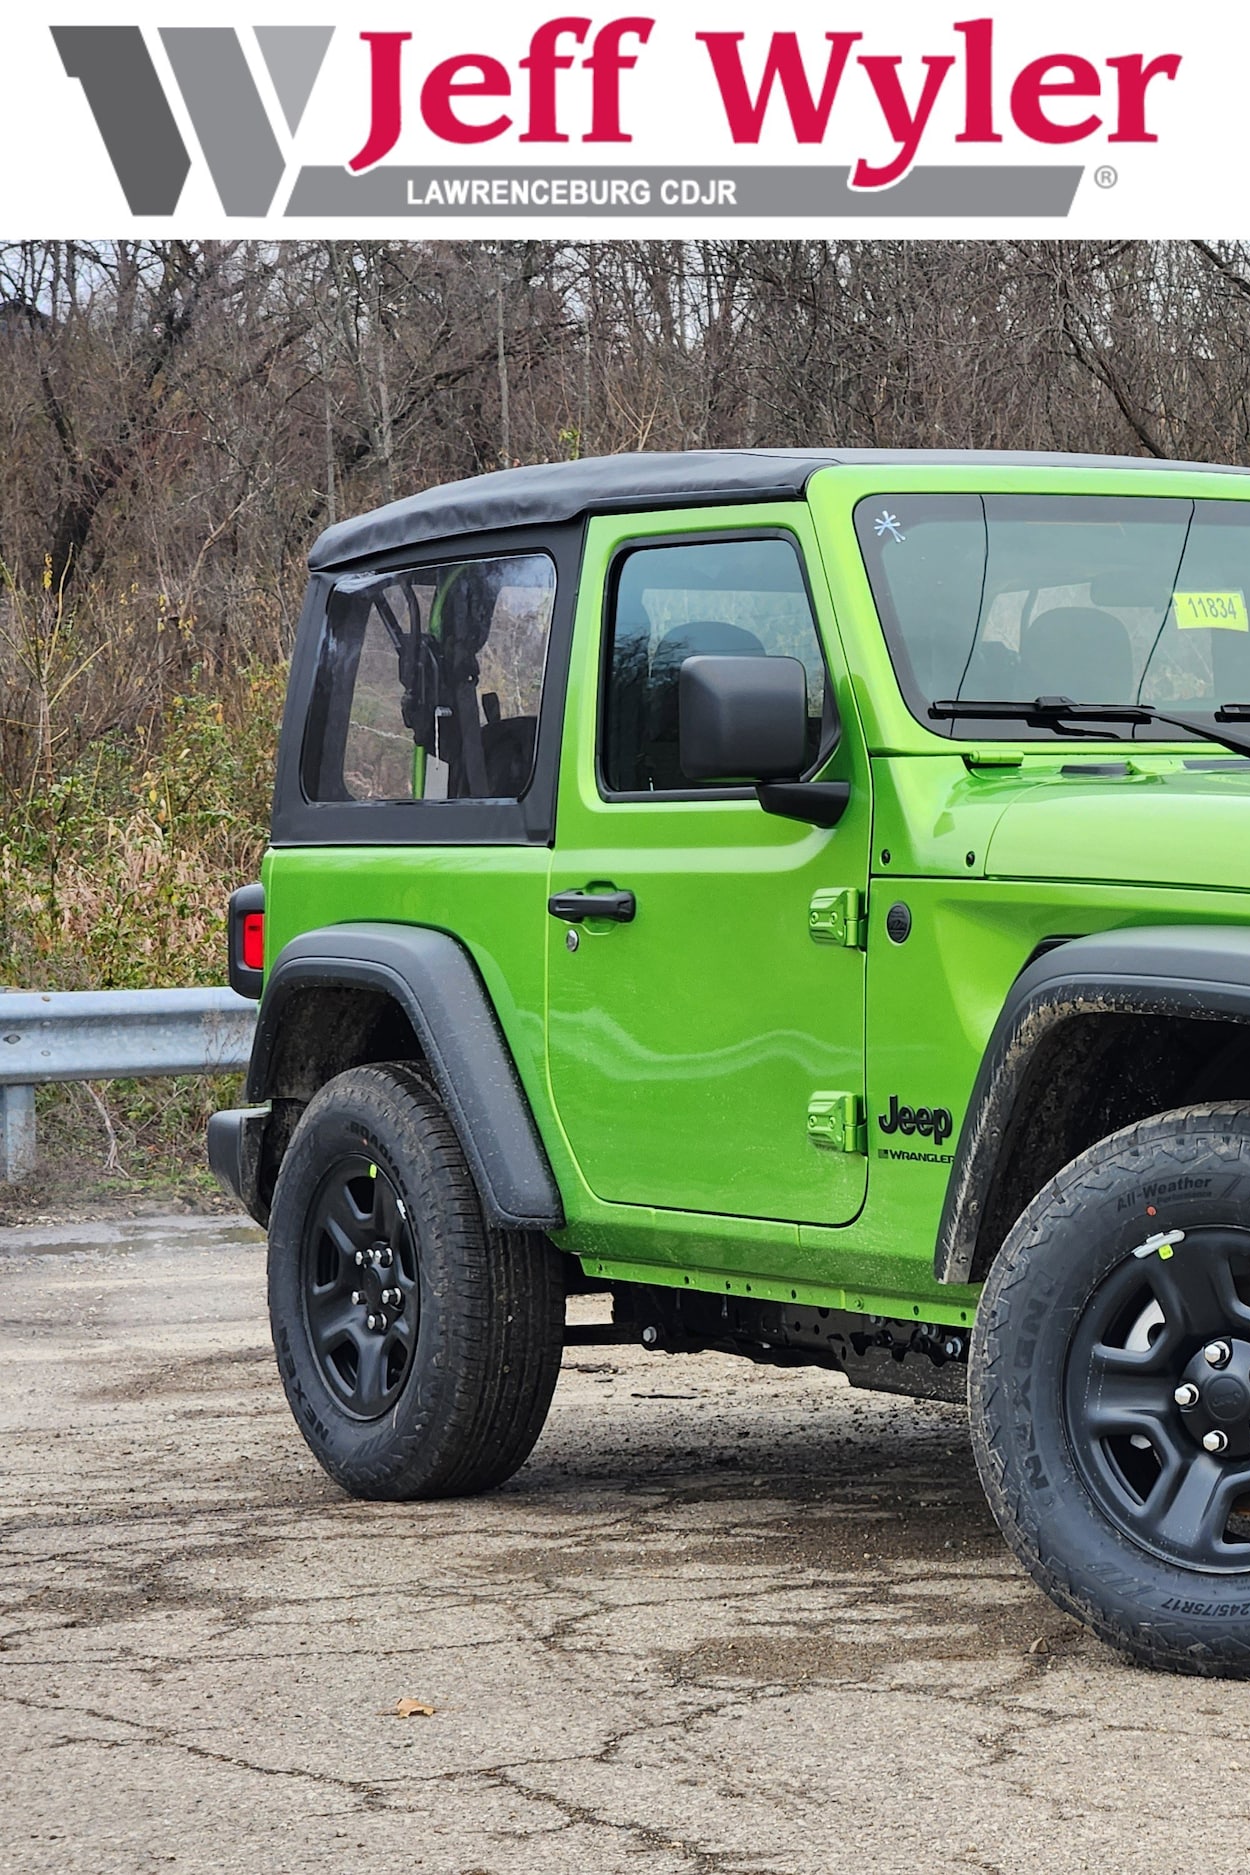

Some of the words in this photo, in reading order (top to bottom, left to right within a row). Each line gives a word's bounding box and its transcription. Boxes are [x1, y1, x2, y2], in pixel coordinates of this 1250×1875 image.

[1188, 597, 1236, 619] 11834
[878, 1095, 952, 1145] Jeep
[890, 1149, 954, 1163] WRANGLER
[1117, 1177, 1212, 1211] All-Weather
[1161, 1597, 1250, 1617] 245/75R17
